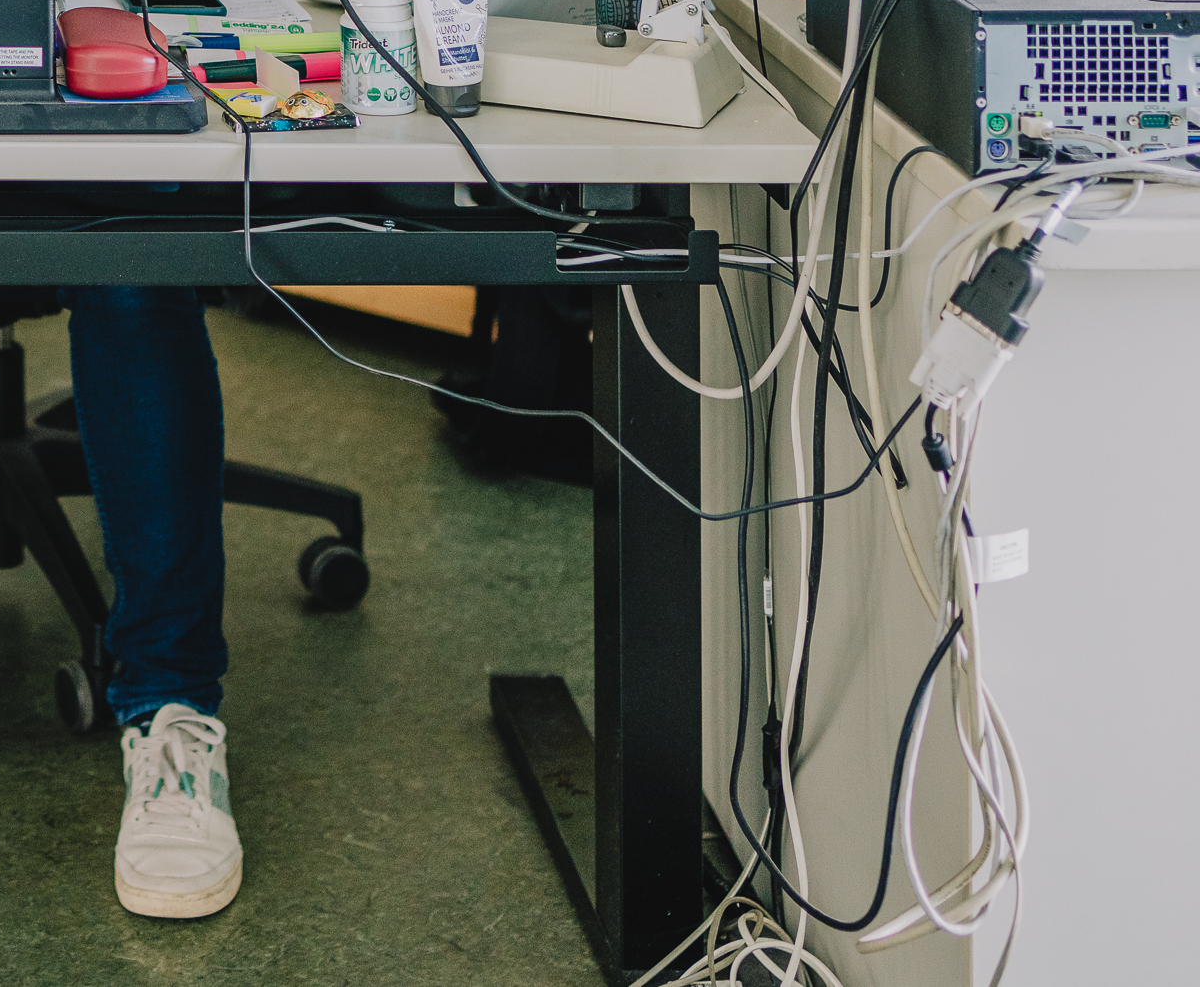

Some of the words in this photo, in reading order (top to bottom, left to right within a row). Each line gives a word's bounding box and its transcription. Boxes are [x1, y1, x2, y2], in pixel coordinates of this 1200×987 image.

[436, 23, 471, 35] ALMOND
[436, 34, 466, 46] DREAM
[350, 42, 417, 74] WHITE
